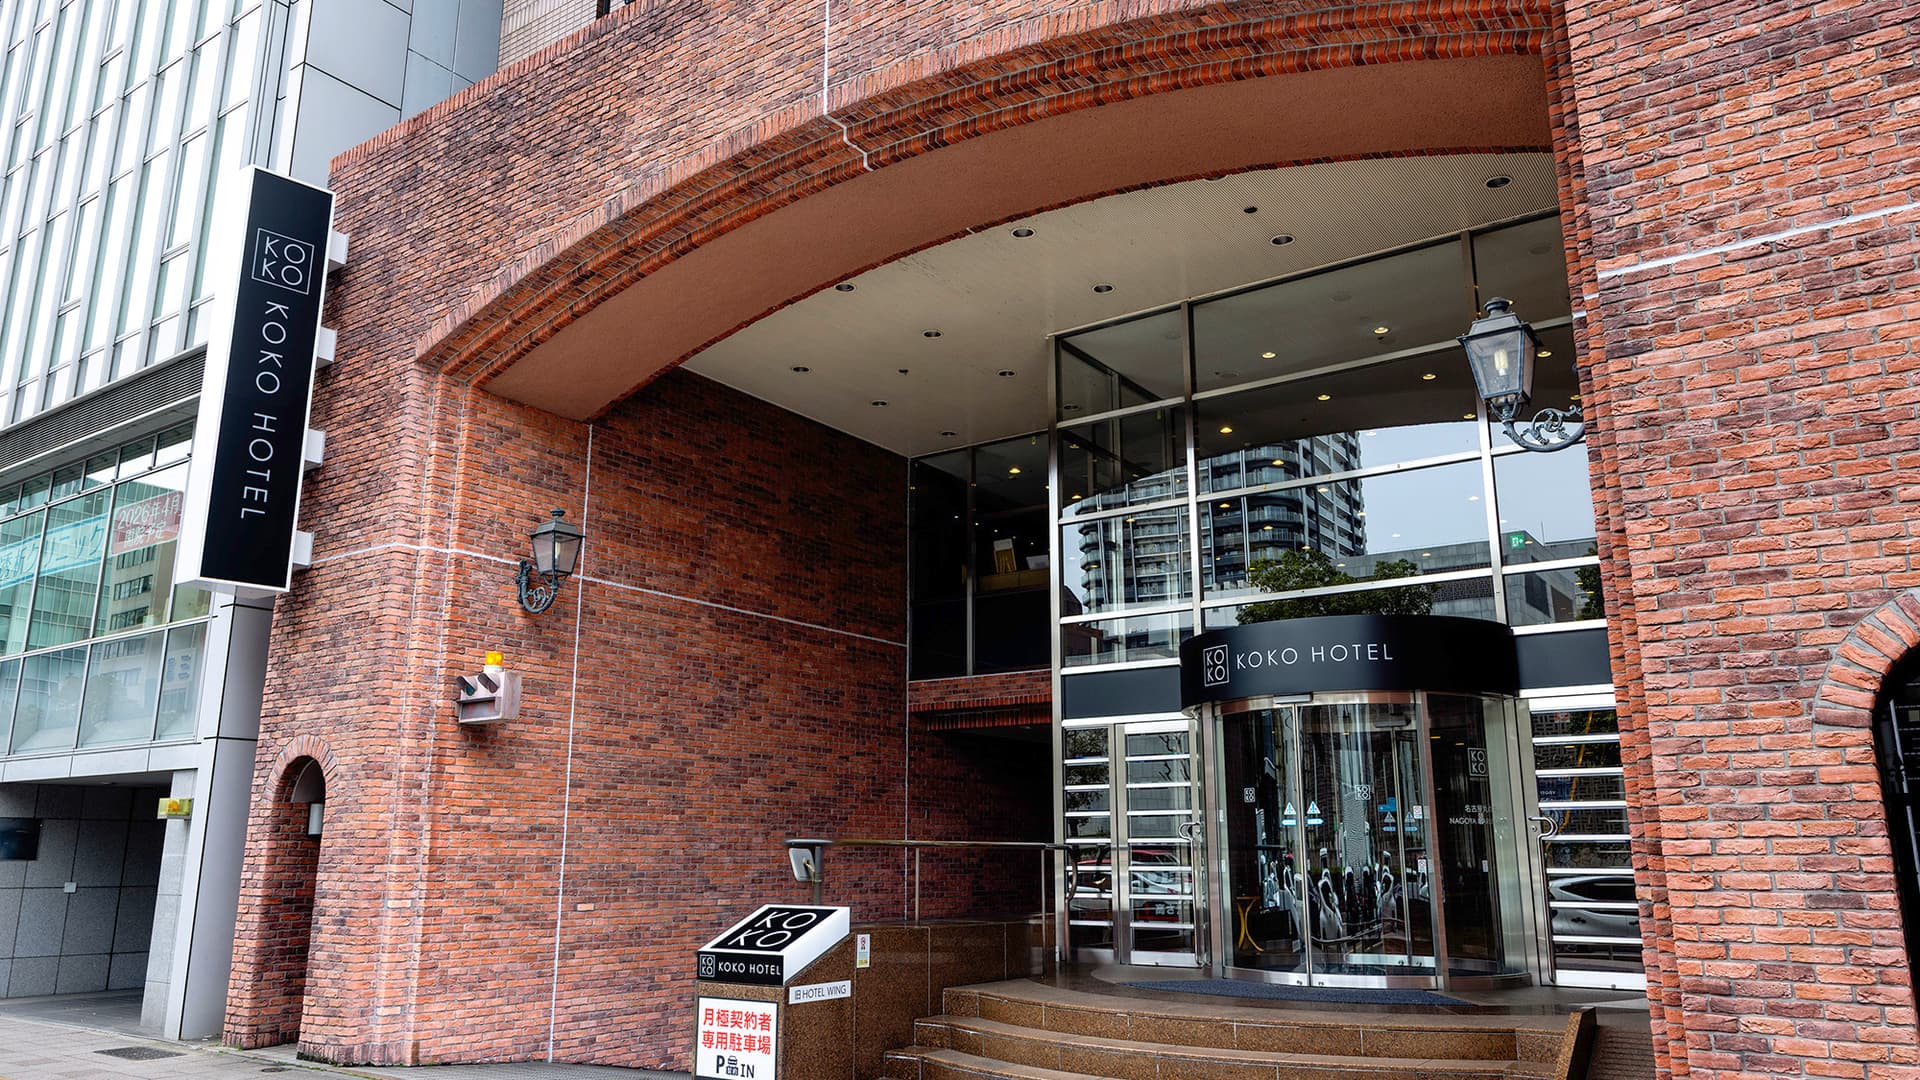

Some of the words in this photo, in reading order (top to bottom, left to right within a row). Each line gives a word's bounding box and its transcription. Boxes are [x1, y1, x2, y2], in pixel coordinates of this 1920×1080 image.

[264, 236, 306, 264] KO
[261, 258, 303, 286] KO
[256, 301, 289, 394] KOKO
[241, 412, 277, 519] HOTEL
[1206, 649, 1225, 666] KO
[1237, 647, 1298, 670] KOKO
[1312, 644, 1394, 662] HOTEL
[1207, 665, 1226, 682] KO
[1470, 751, 1485, 761] KO
[1471, 763, 1486, 773] KO
[755, 911, 817, 929] KO
[728, 929, 792, 947] KO
[702, 957, 713, 966] KO
[702, 966, 713, 975] KO
[718, 961, 746, 973] KOKO
[749, 963, 781, 975] HOTEL
[802, 988, 825, 999] HOTEL
[827, 984, 847, 996] WING
[703, 1008, 772, 1032] 月極契約者
[702, 1030, 772, 1055] 専用駐車場
[716, 1055, 725, 1073] P
[740, 1063, 755, 1078] IN
